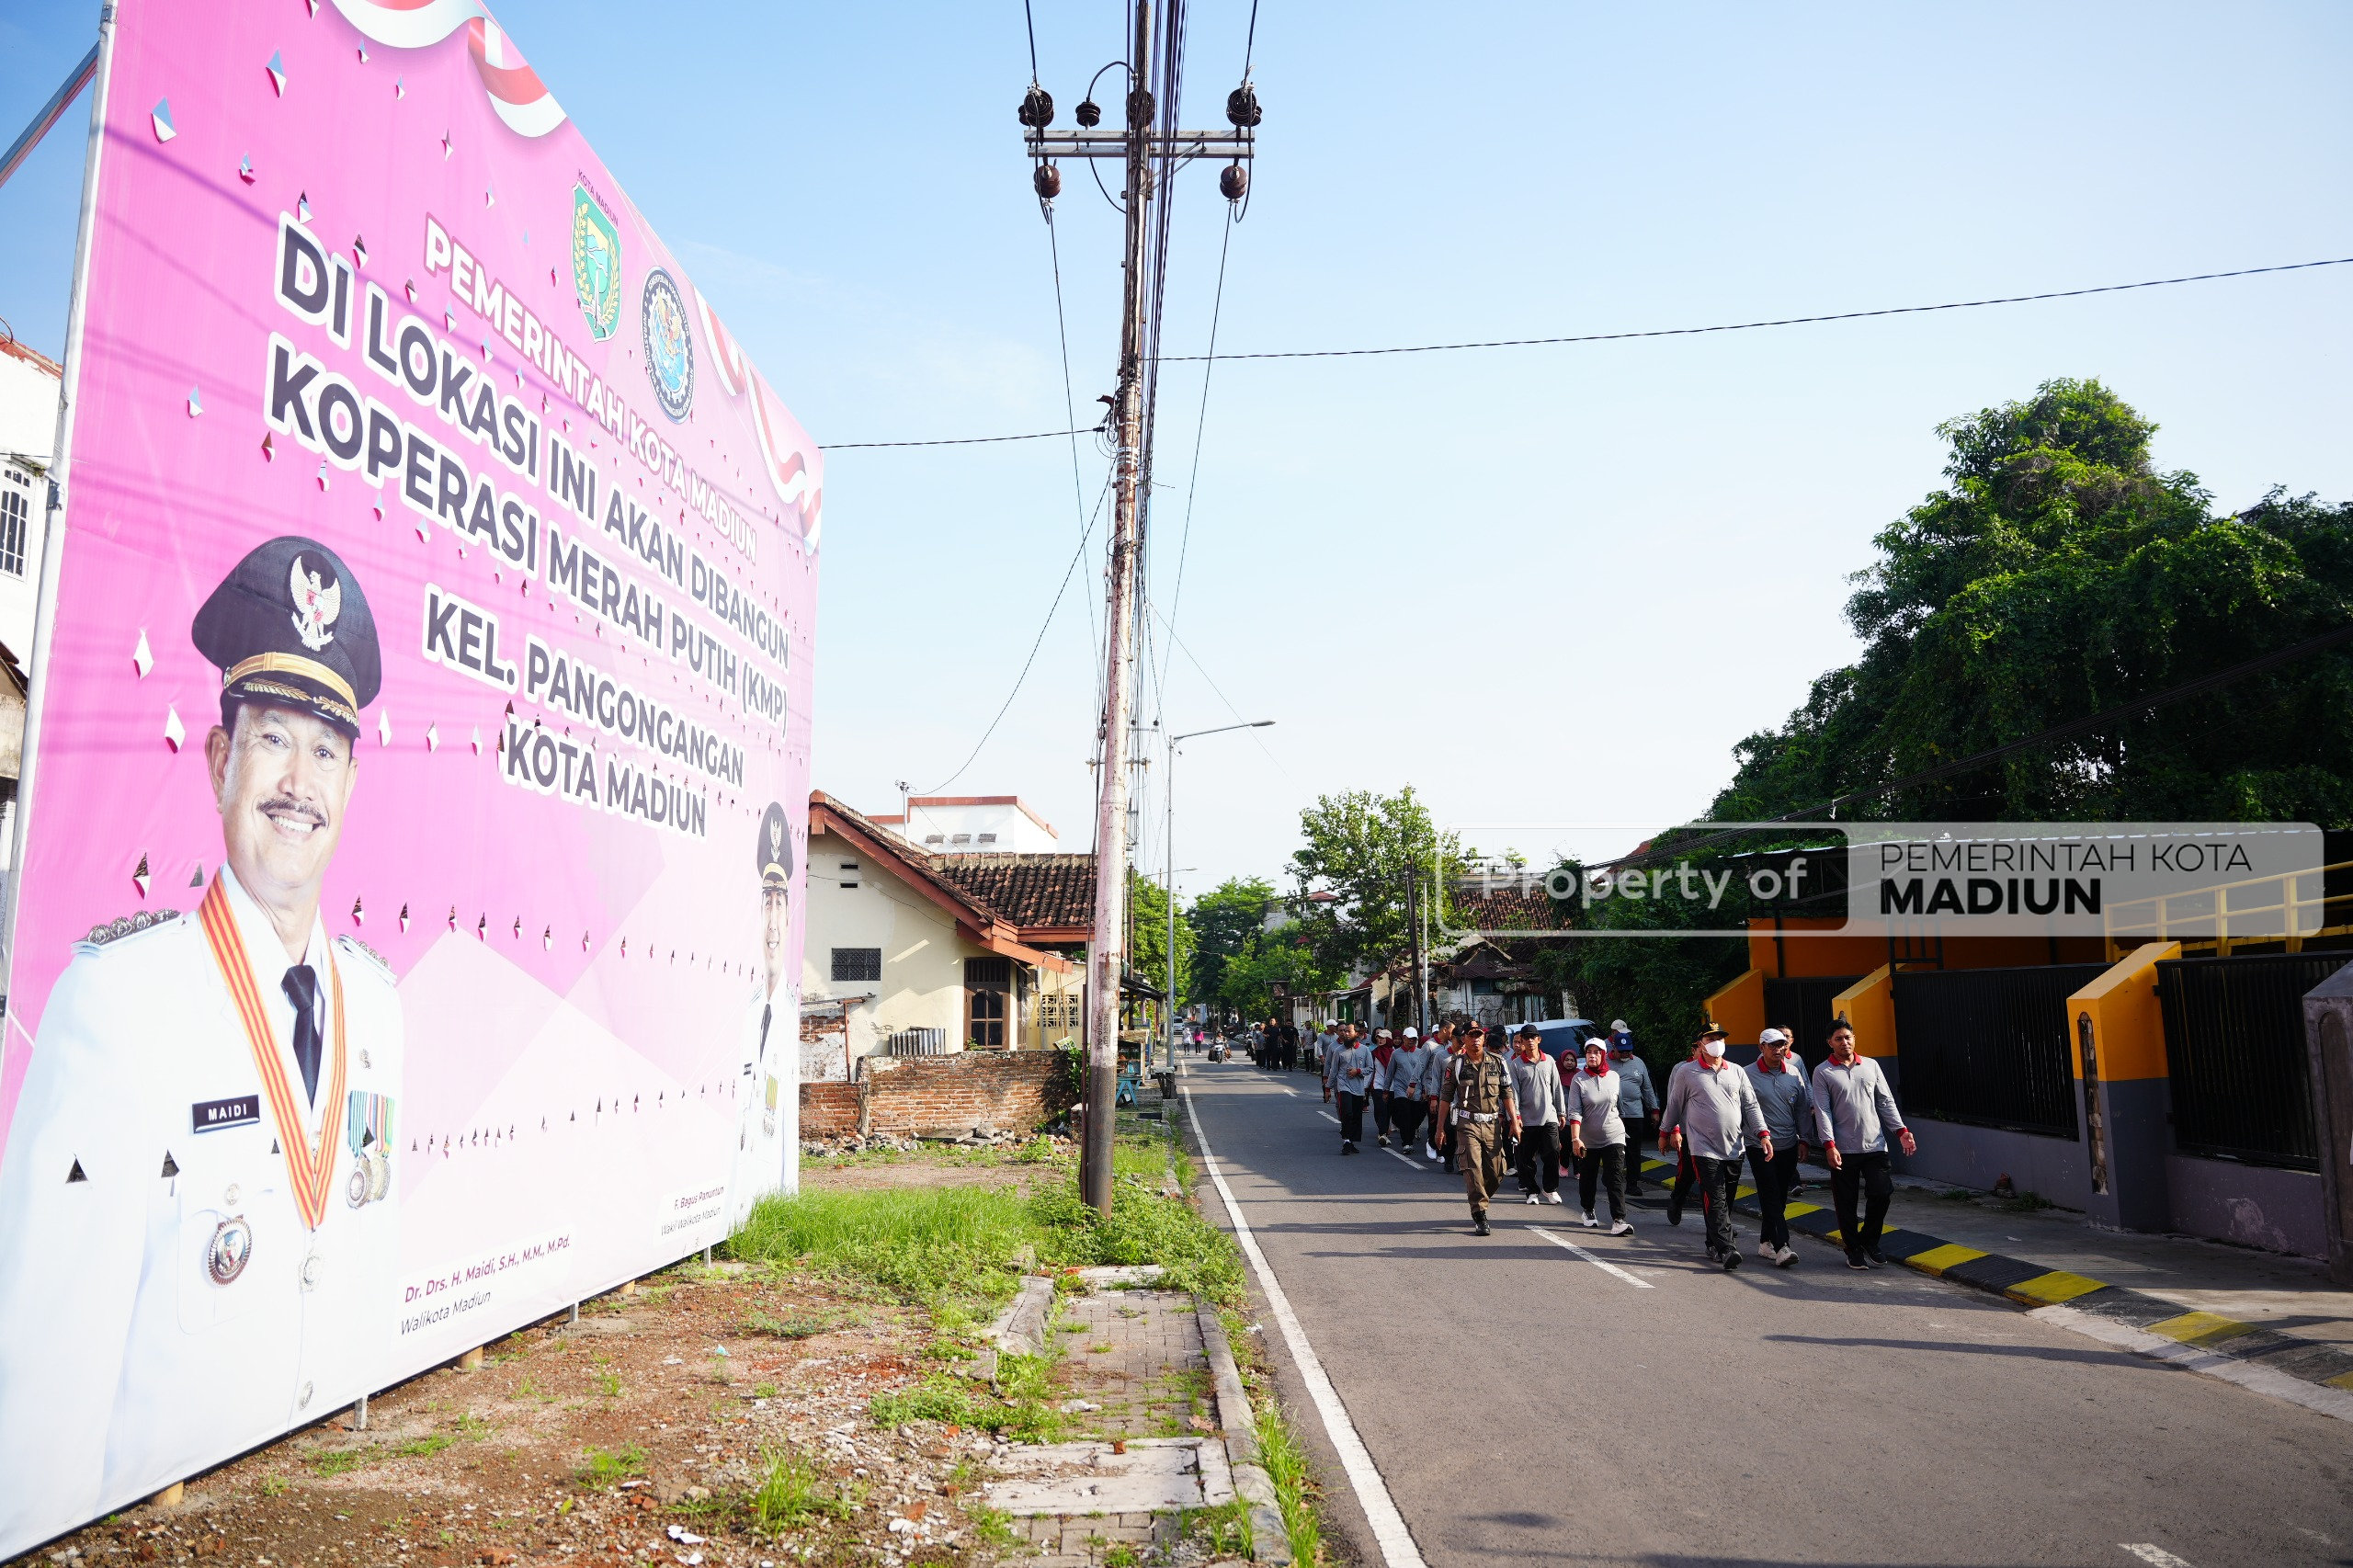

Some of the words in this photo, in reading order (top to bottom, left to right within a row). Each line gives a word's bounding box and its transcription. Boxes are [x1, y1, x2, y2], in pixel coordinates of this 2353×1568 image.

[281, 223, 348, 338] DI
[369, 292, 540, 478] LOKASI
[551, 437, 595, 520] INI
[605, 489, 683, 586] AKAN
[692, 553, 788, 668] DIBANGUN
[427, 217, 623, 442] PEMERINTAH
[630, 410, 687, 501] KOTA
[691, 469, 756, 565] MADIUN
[272, 345, 537, 571] KOPERASI
[550, 528, 663, 649] MERAH
[672, 613, 736, 695] PUTIH
[742, 660, 788, 738] (KMP)
[427, 593, 516, 686] KEL.
[529, 642, 743, 788] PANGONGANGAN
[507, 722, 597, 802] KOTA
[608, 761, 705, 837] MADIUN
[208, 1103, 247, 1121] MAIDI
[680, 1194, 699, 1209] Bagus
[401, 1305, 449, 1336] Walikota
[452, 1290, 491, 1315] Madiun
[404, 1286, 422, 1302] Dr.
[426, 1278, 448, 1295] Drs.
[451, 1270, 462, 1287] H.
[465, 1257, 495, 1282] Maidi,
[547, 1233, 570, 1254] M.Pd.
